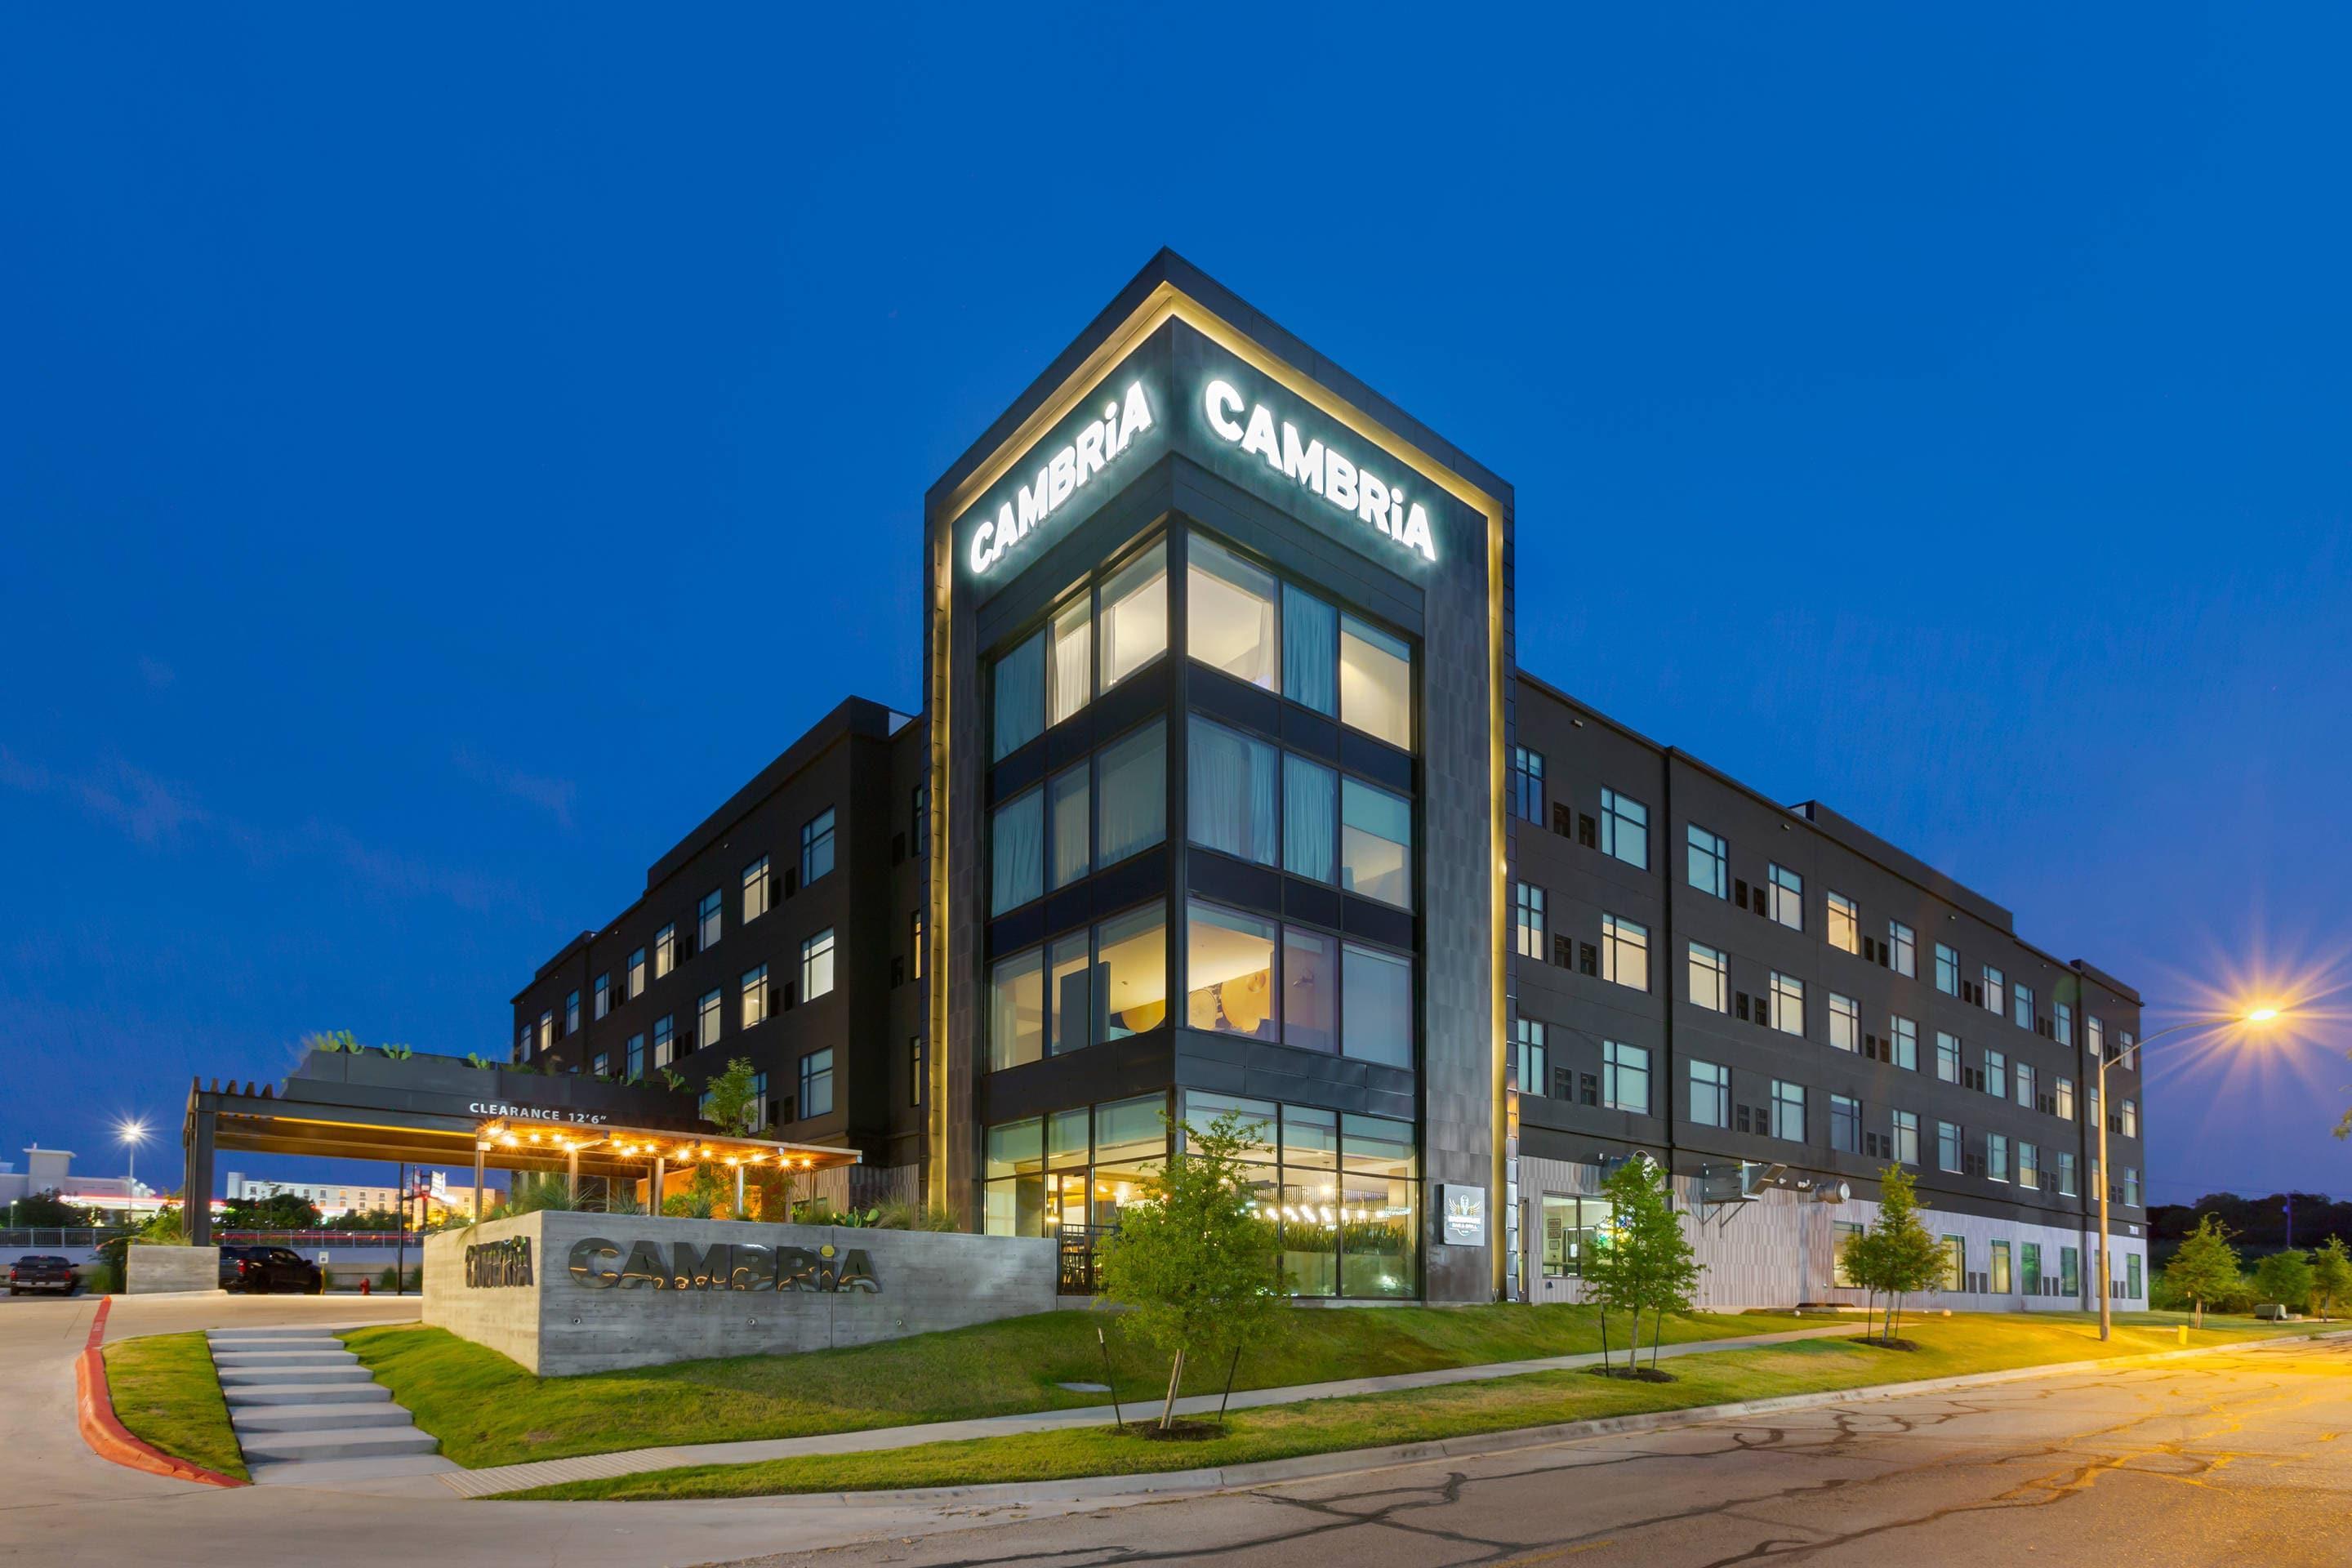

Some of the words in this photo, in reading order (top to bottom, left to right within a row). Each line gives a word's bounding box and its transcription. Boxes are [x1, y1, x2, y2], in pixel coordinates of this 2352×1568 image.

[970, 381, 1153, 573] CAMBRiA
[1205, 379, 1437, 562] CAMBRiA
[470, 1103, 560, 1120] CLEARANCE
[568, 1112, 607, 1124] 12'6"
[568, 1236, 883, 1294] CAMBRiA
